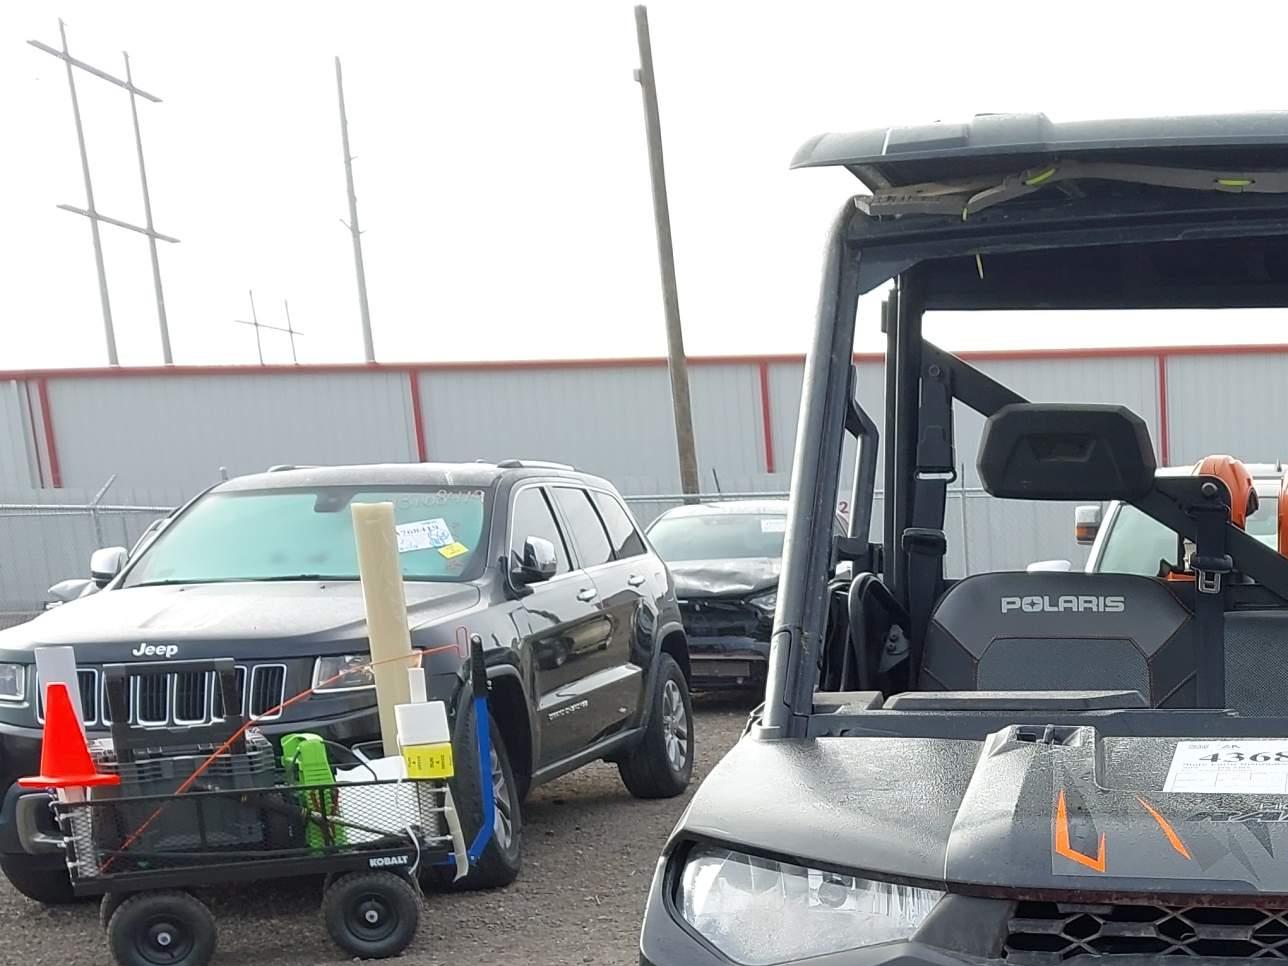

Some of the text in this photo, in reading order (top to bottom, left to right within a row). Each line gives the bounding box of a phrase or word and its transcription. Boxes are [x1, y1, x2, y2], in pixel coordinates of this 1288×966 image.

[839, 501, 848, 513] 2
[1001, 596, 1125, 613] POLARIS
[132, 643, 178, 658] Jeep
[369, 855, 408, 868] KOBALT
